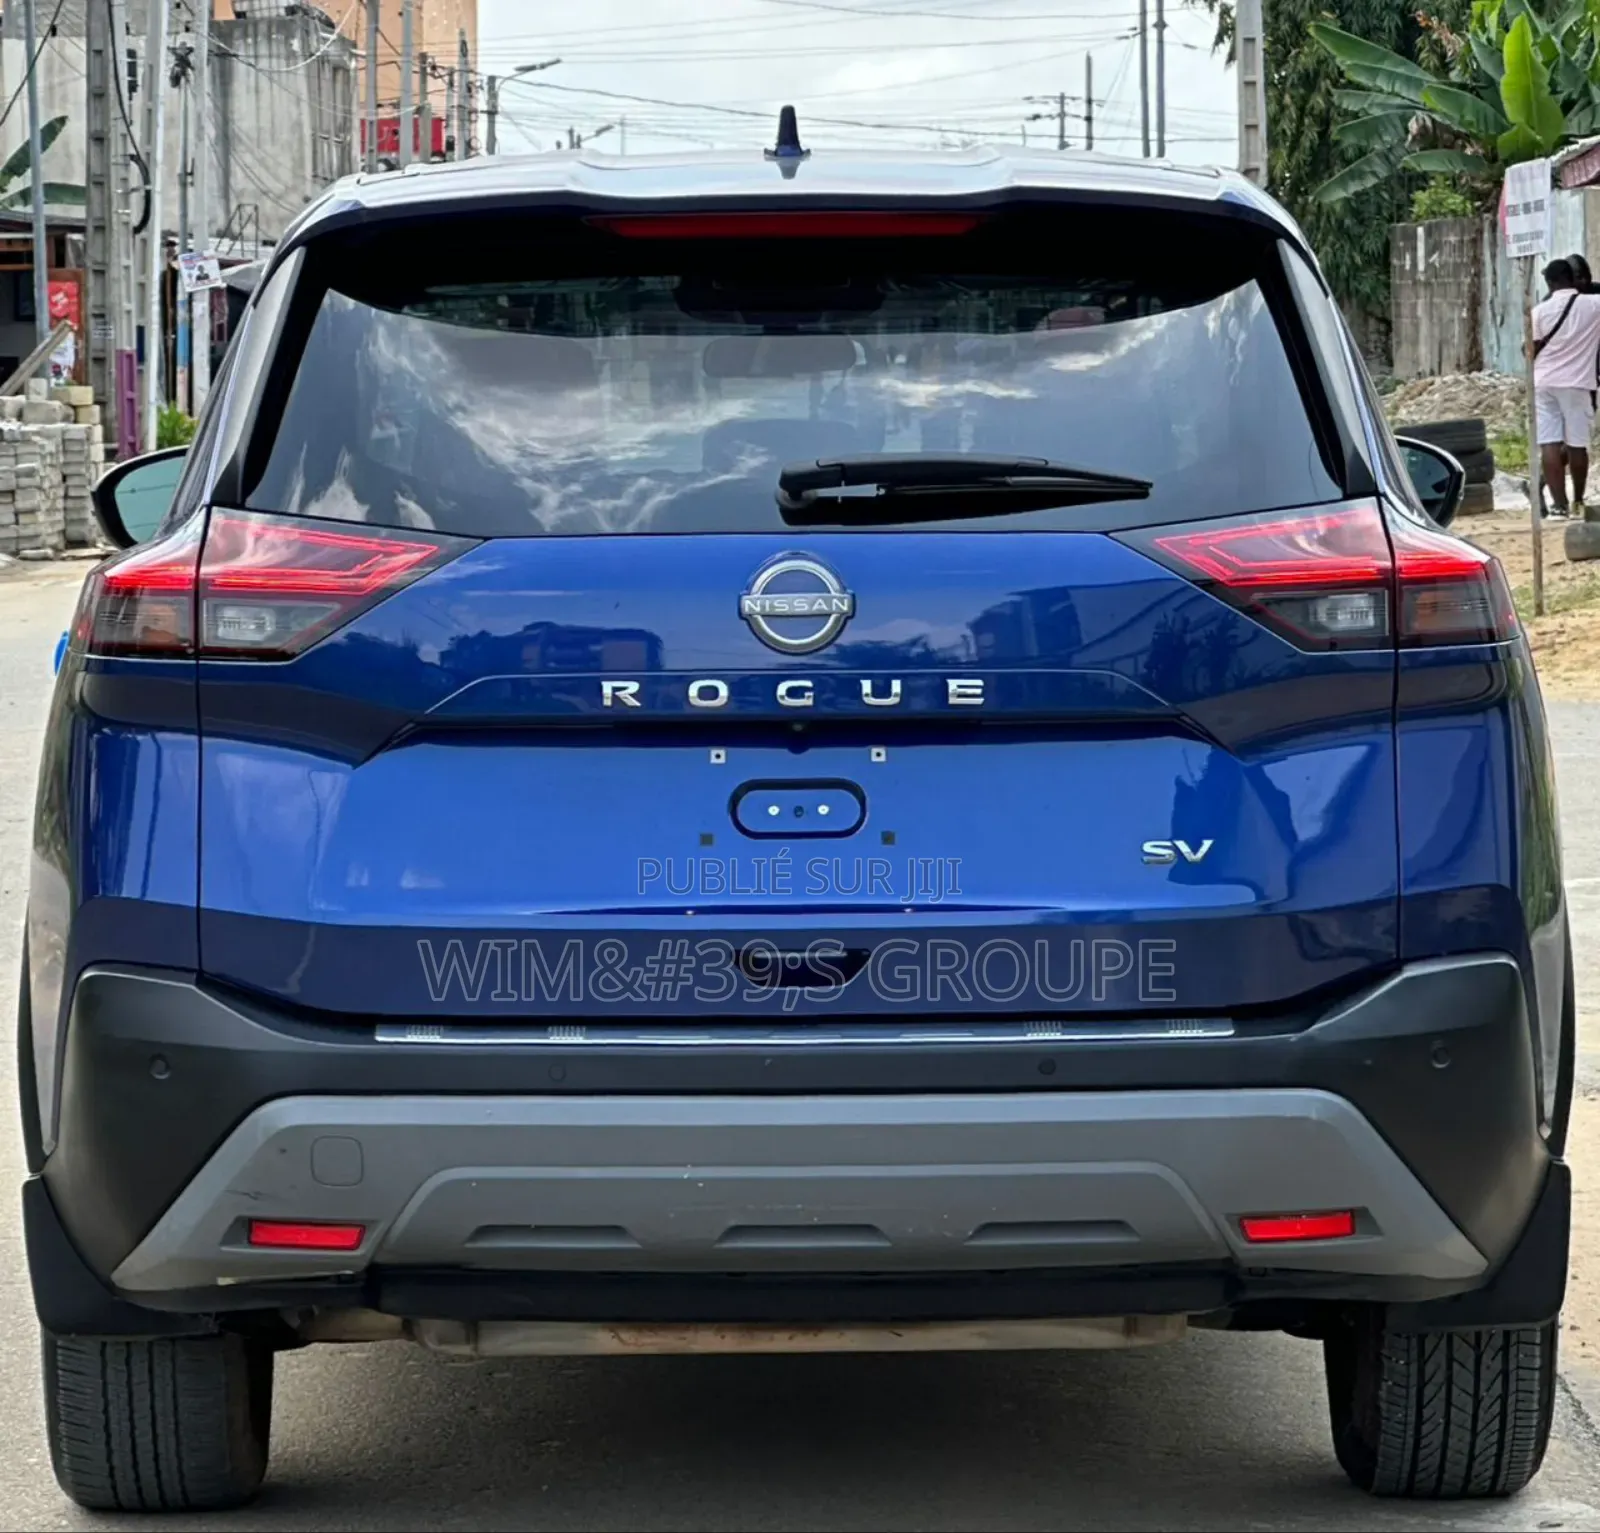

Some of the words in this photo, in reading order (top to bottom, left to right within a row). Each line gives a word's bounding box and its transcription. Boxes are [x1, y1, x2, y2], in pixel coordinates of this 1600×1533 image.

[744, 597, 849, 613] NISSAN
[601, 678, 985, 708] ROGUE
[1141, 838, 1215, 865] SV
